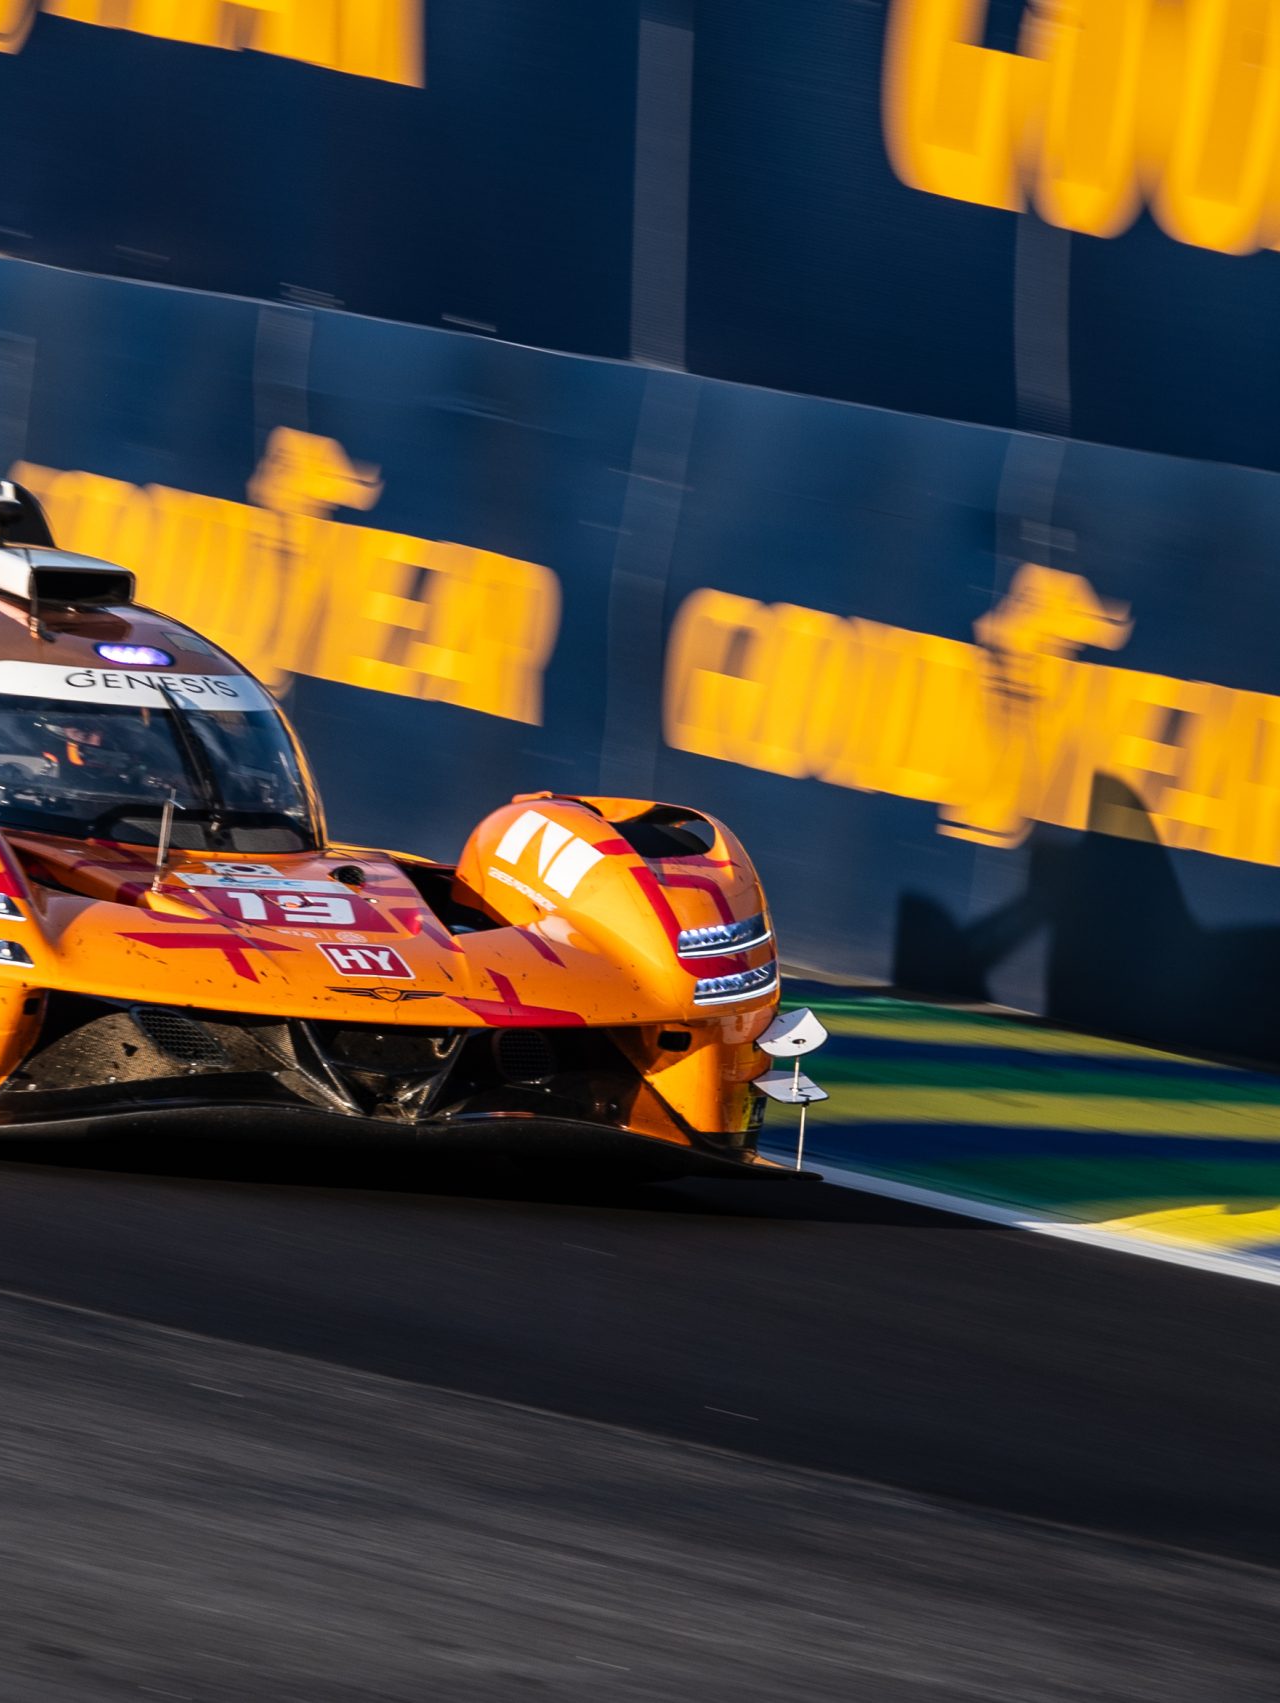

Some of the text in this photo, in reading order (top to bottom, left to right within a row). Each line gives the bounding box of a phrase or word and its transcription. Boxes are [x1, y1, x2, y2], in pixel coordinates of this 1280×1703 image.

[880, 0, 1280, 256] GOO
[65, 670, 239, 698] GENESIS
[663, 586, 1280, 868] GOODYEA
[226, 892, 356, 924] 19
[327, 948, 393, 971] HY
